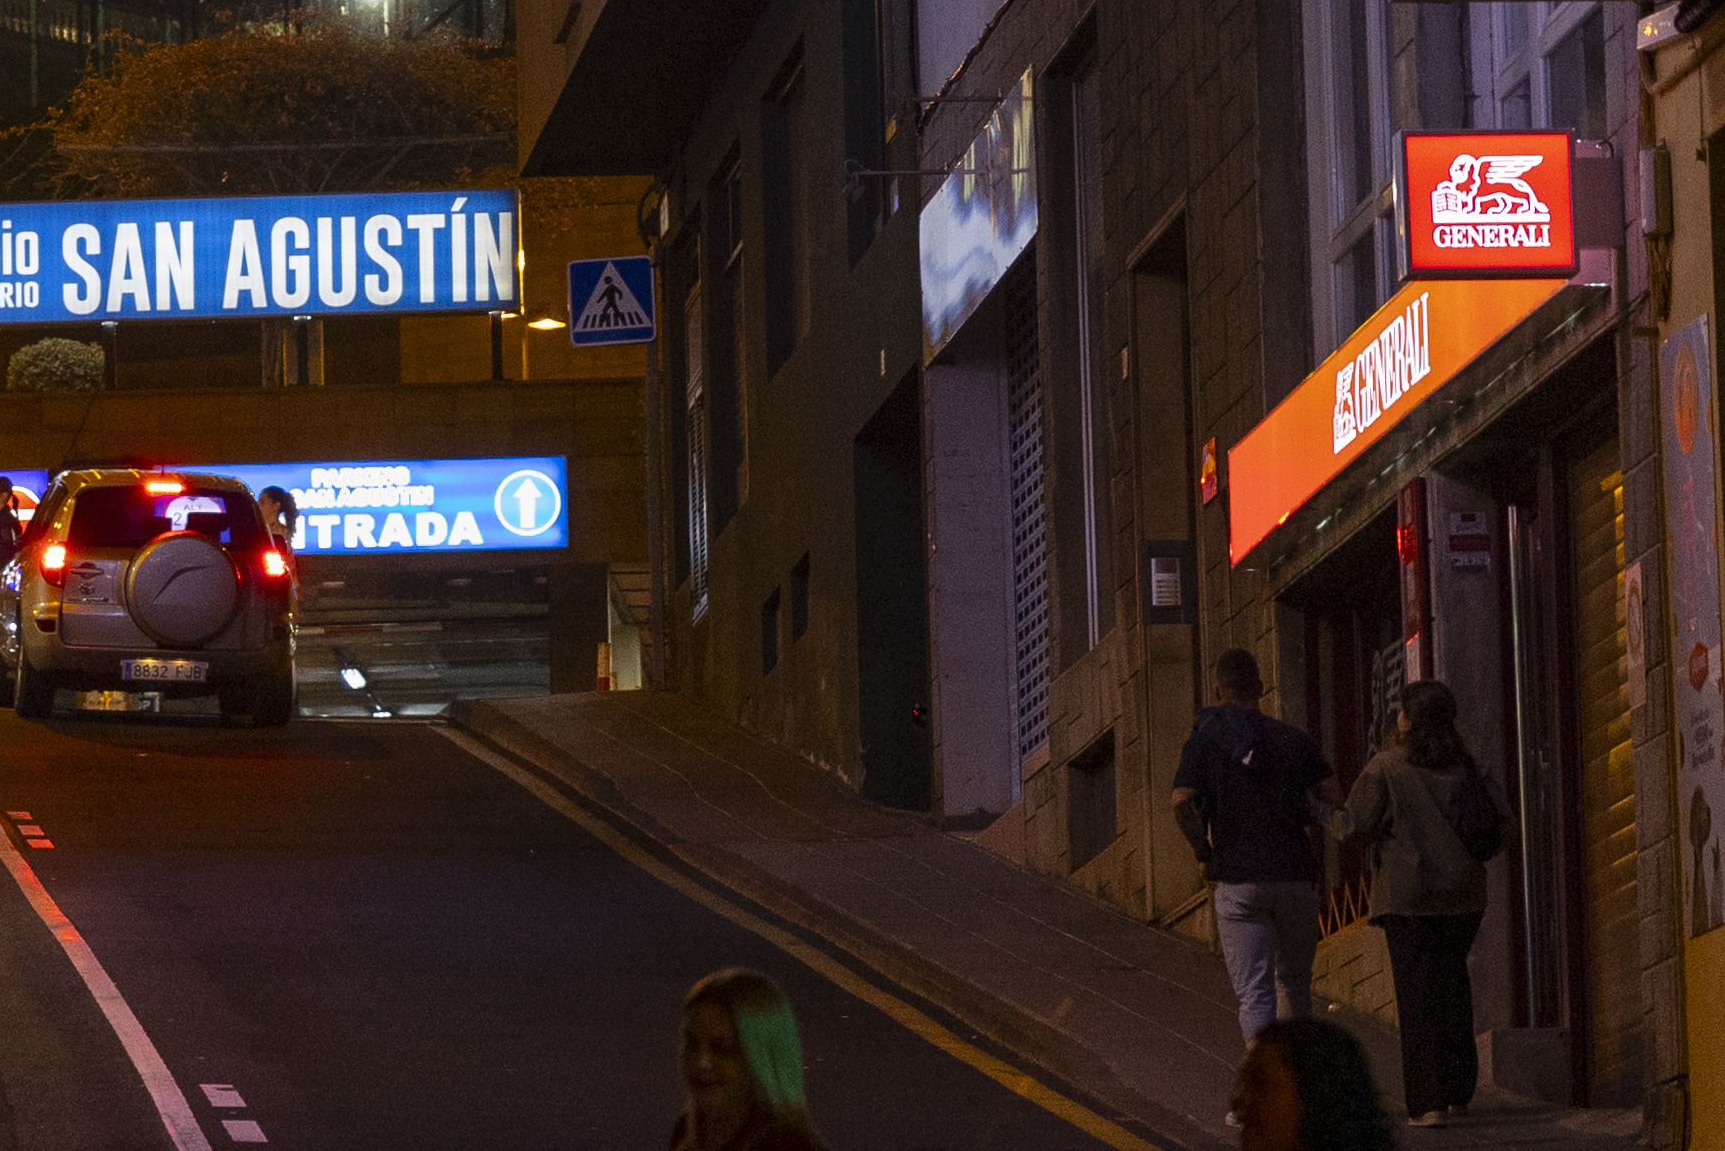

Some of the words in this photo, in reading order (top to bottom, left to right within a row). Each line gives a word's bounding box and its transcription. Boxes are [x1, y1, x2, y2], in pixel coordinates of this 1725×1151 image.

[1432, 224, 1551, 248] GENERALI
[62, 220, 195, 315] SAN
[222, 197, 513, 309] AGUSTÍN
[1353, 291, 1431, 434] GENERALI
[291, 511, 484, 549] TRADA
[133, 664, 168, 679] 8832
[175, 665, 202, 679] FJB
